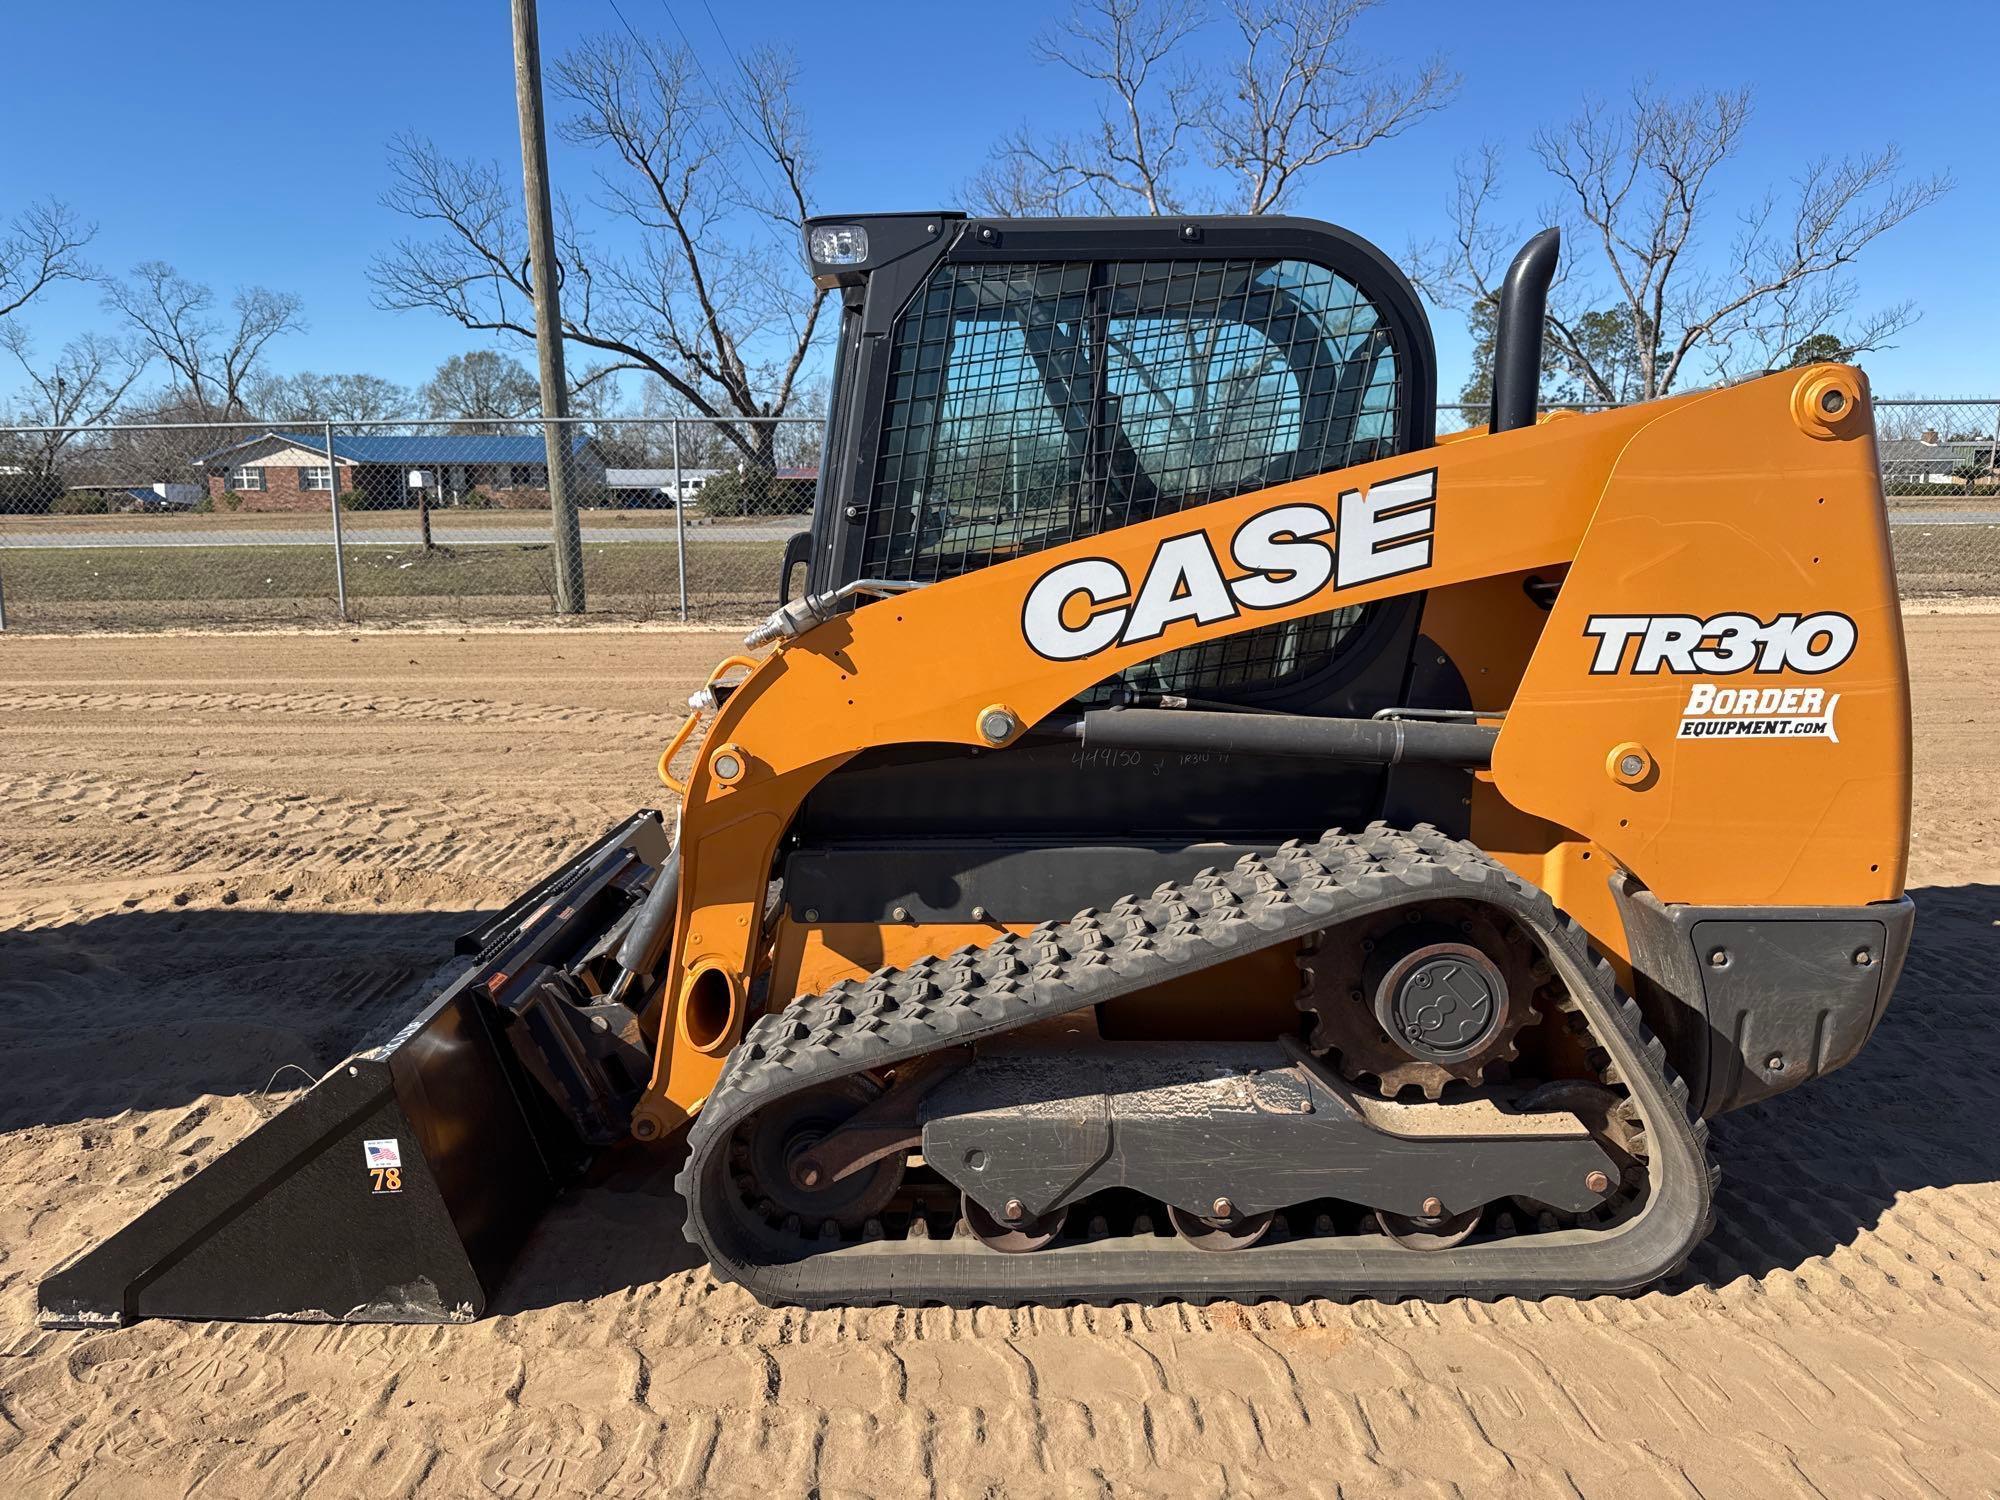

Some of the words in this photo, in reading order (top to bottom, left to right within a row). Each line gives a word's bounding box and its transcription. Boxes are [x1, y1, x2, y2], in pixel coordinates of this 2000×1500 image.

[1021, 467, 1438, 661] CASE
[1582, 611, 1858, 675] TR310
[1683, 683, 1826, 715] BORDER
[1681, 720, 1827, 737] EQUIPMENT.COM
